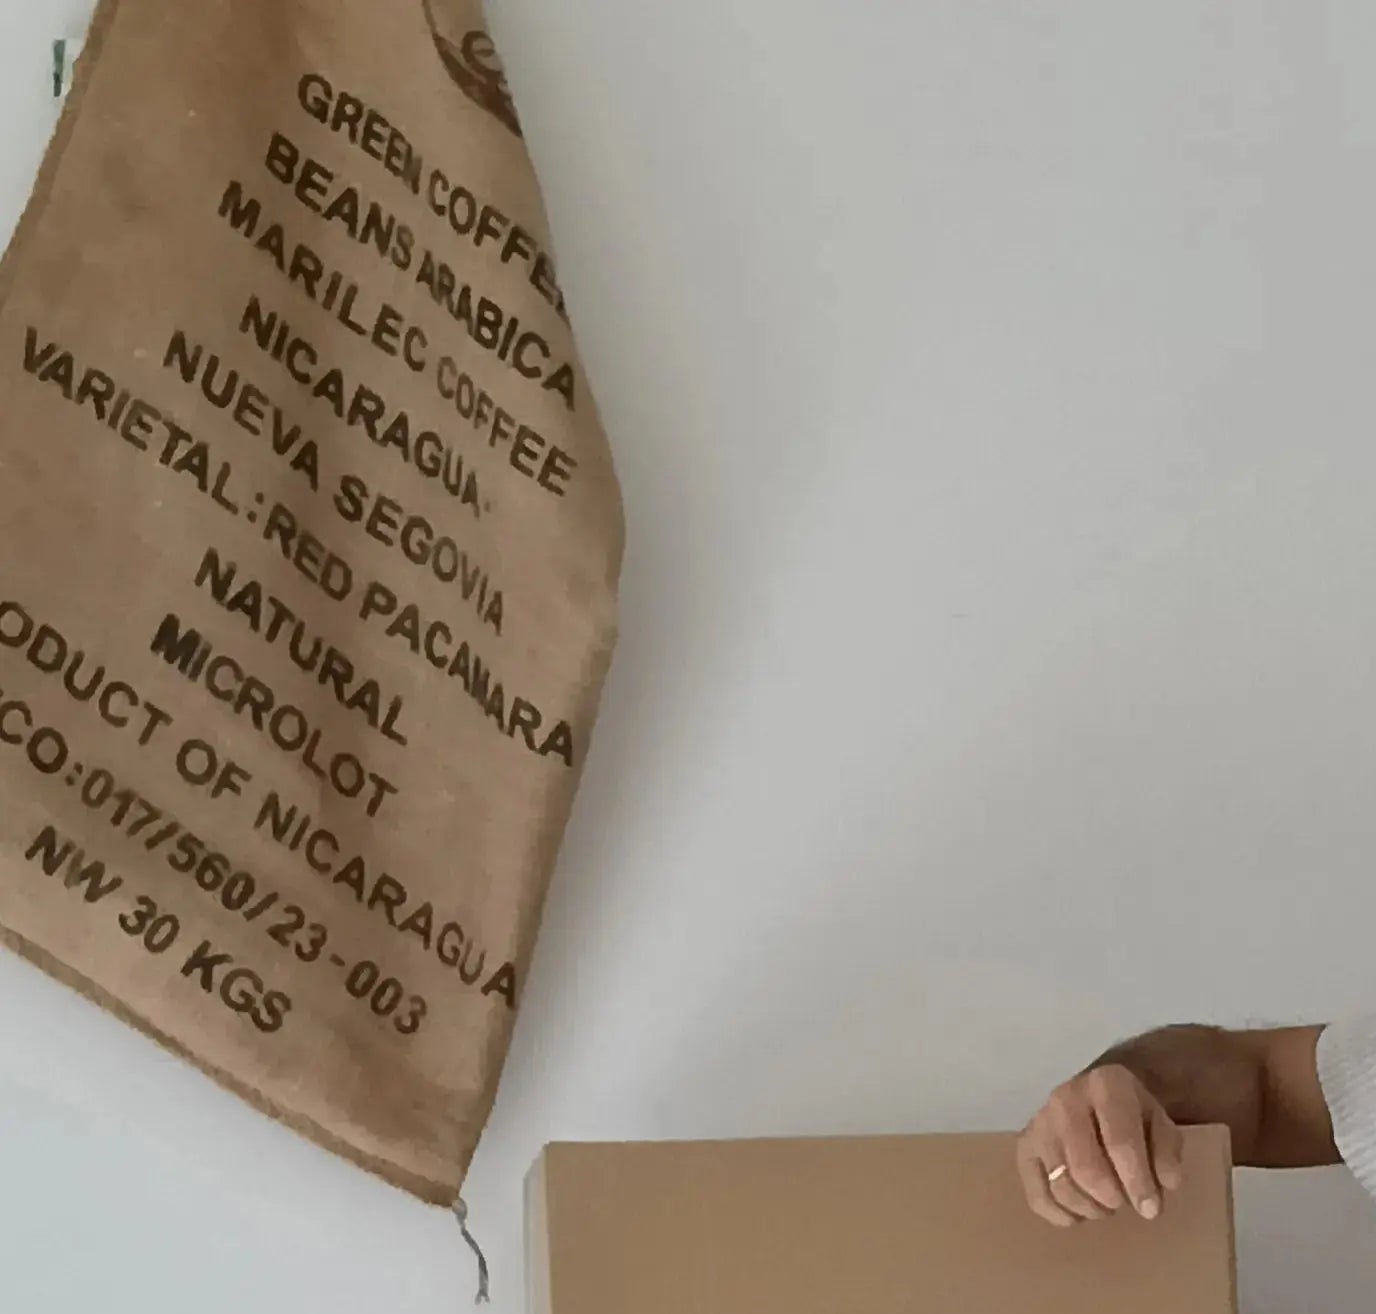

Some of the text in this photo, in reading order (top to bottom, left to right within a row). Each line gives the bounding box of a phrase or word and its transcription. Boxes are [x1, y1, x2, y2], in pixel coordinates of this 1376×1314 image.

[299, 73, 422, 196] GREEN
[217, 180, 578, 497] MARILEC COFFEE
[265, 132, 577, 411] BEANS ARABICA
[163, 331, 504, 636] NUEVA SEGOVIA
[150, 613, 398, 819] MICROLOT
[194, 547, 408, 747] NATURAL
[359, 581, 574, 767] PACAMARA
[0, 687, 428, 1035] CO:017/560/23-003
[24, 826, 293, 1034] NW 30 KGS
[176, 738, 252, 799] OF
[254, 793, 520, 1010] NICARAGUA
